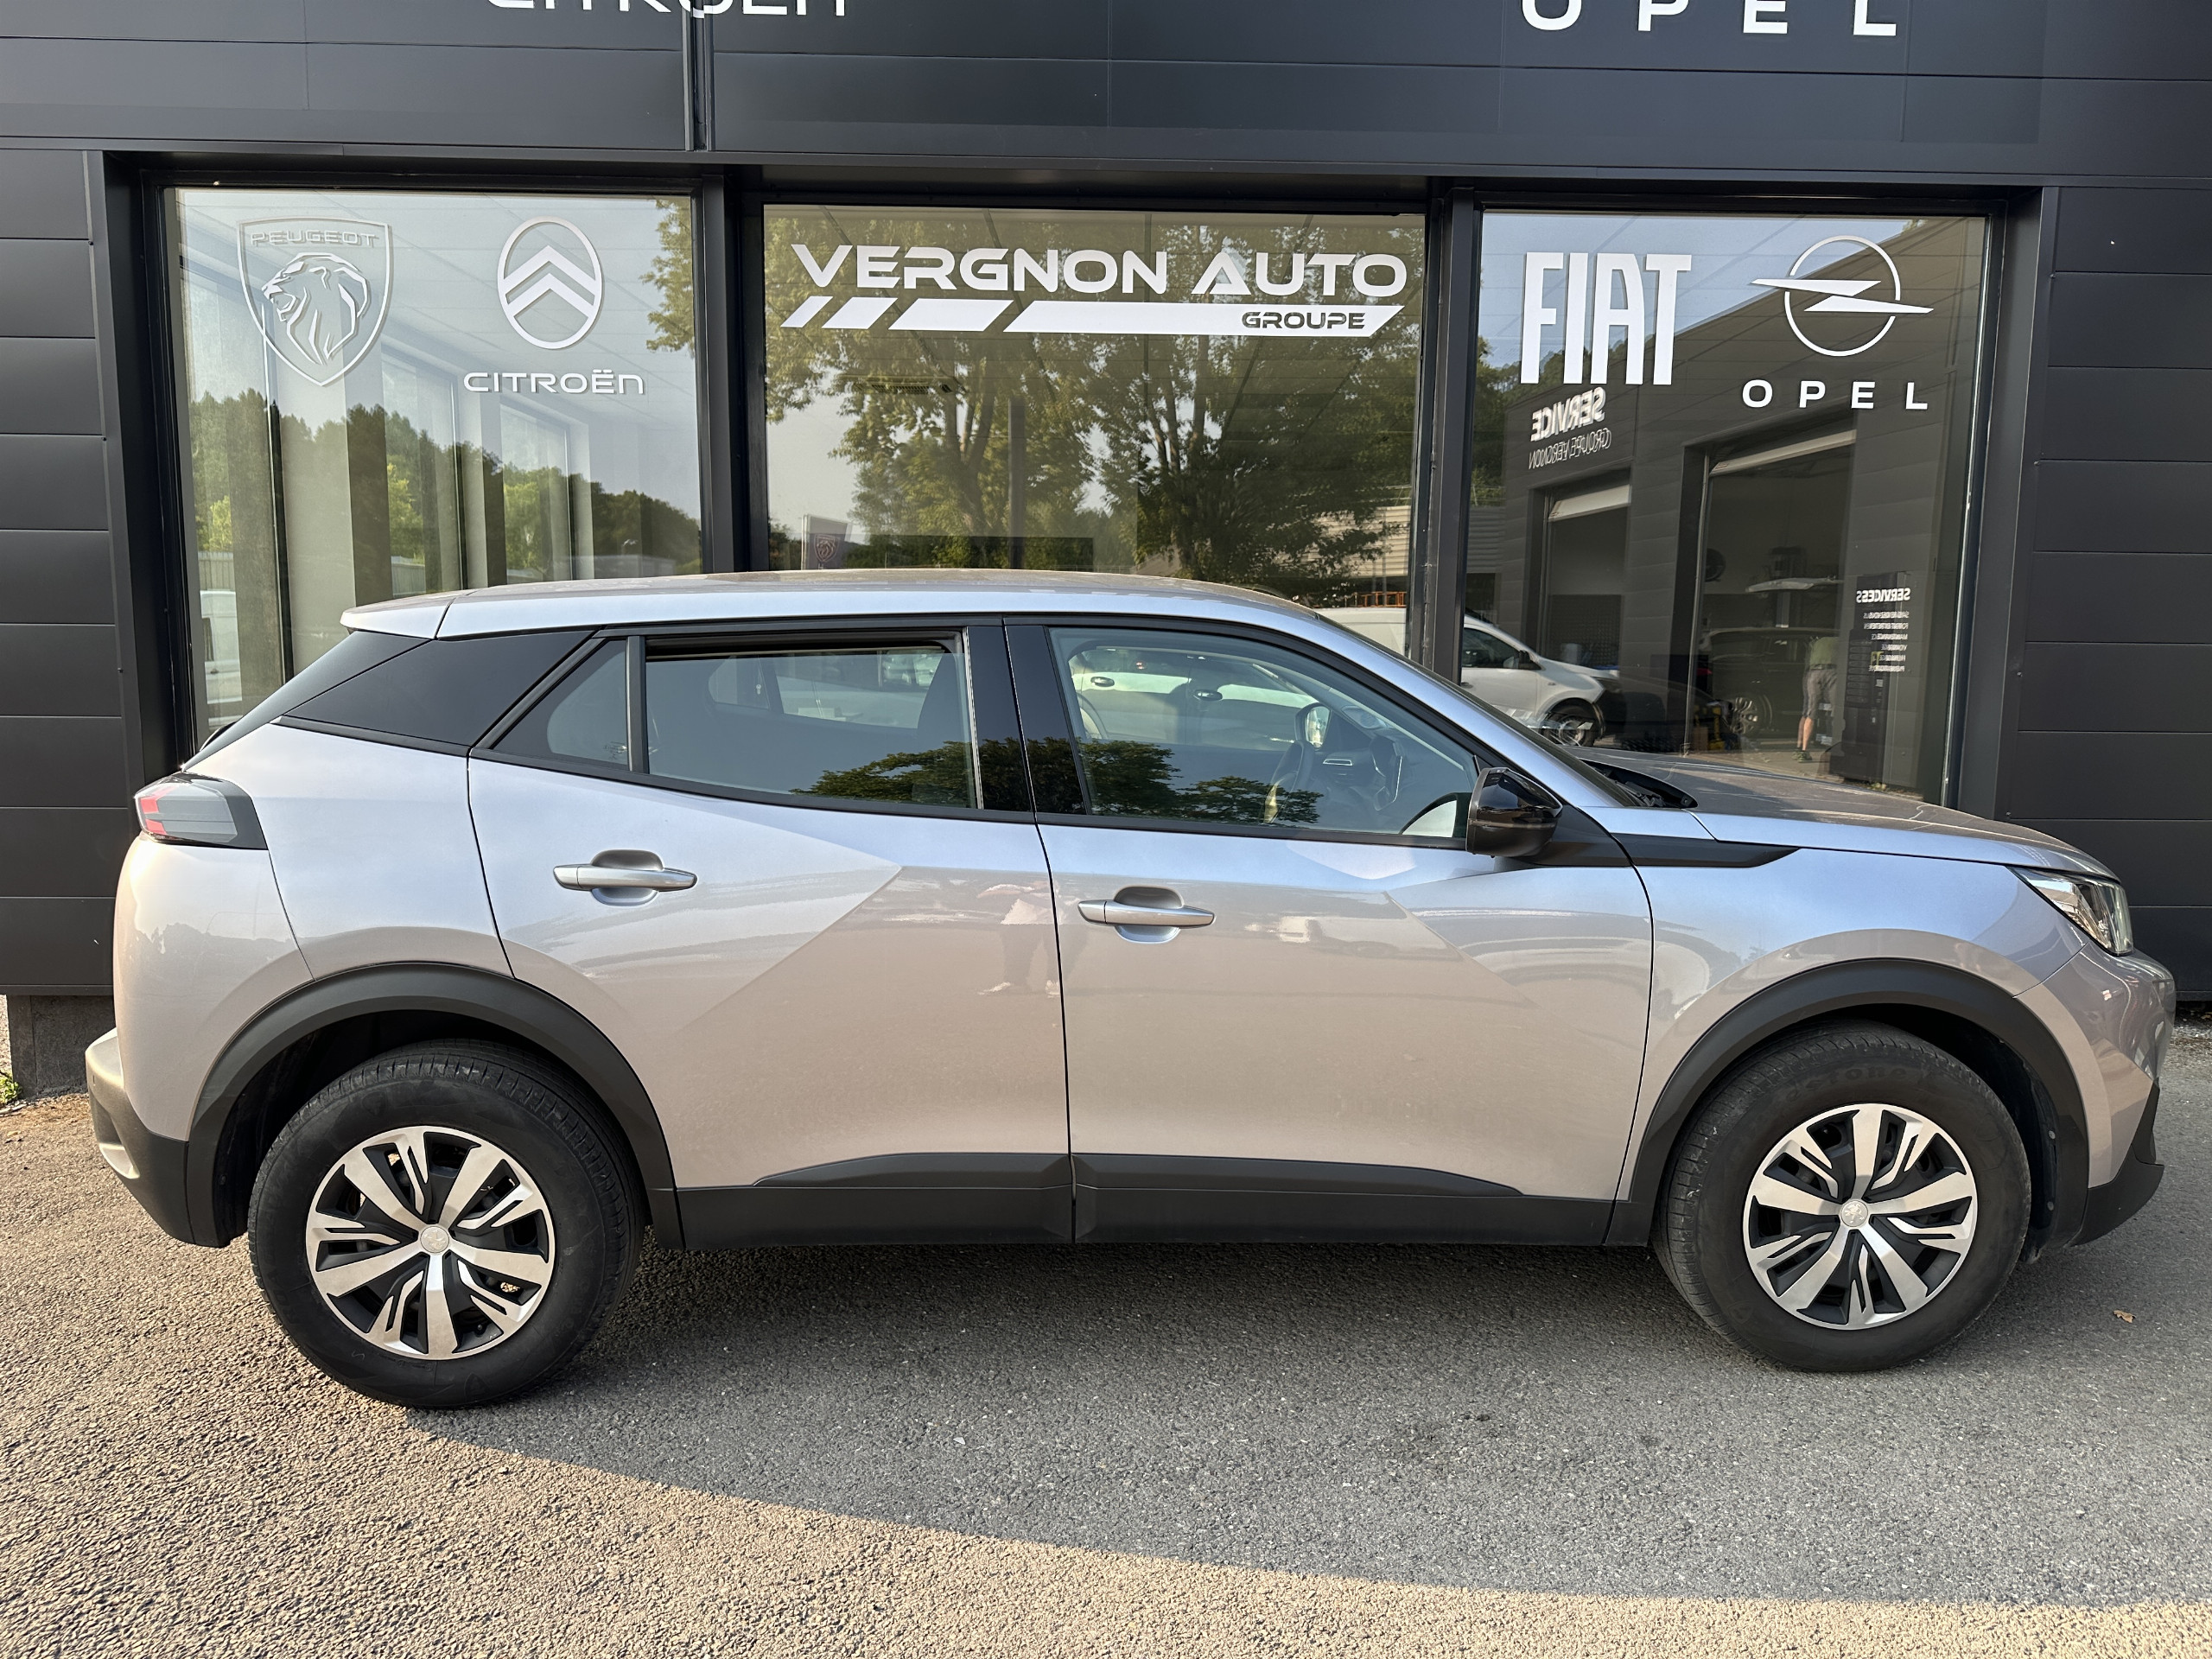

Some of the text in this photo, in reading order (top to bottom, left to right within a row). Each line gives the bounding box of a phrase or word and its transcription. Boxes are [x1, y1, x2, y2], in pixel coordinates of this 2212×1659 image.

[1522, 0, 1897, 36] OPEL
[251, 229, 378, 247] PEUGEOT
[791, 244, 1407, 297] VERGNON AUTO
[1242, 311, 1365, 329] GROUPE
[1521, 251, 1692, 385] FIAT
[1742, 379, 1928, 410] OPEL
